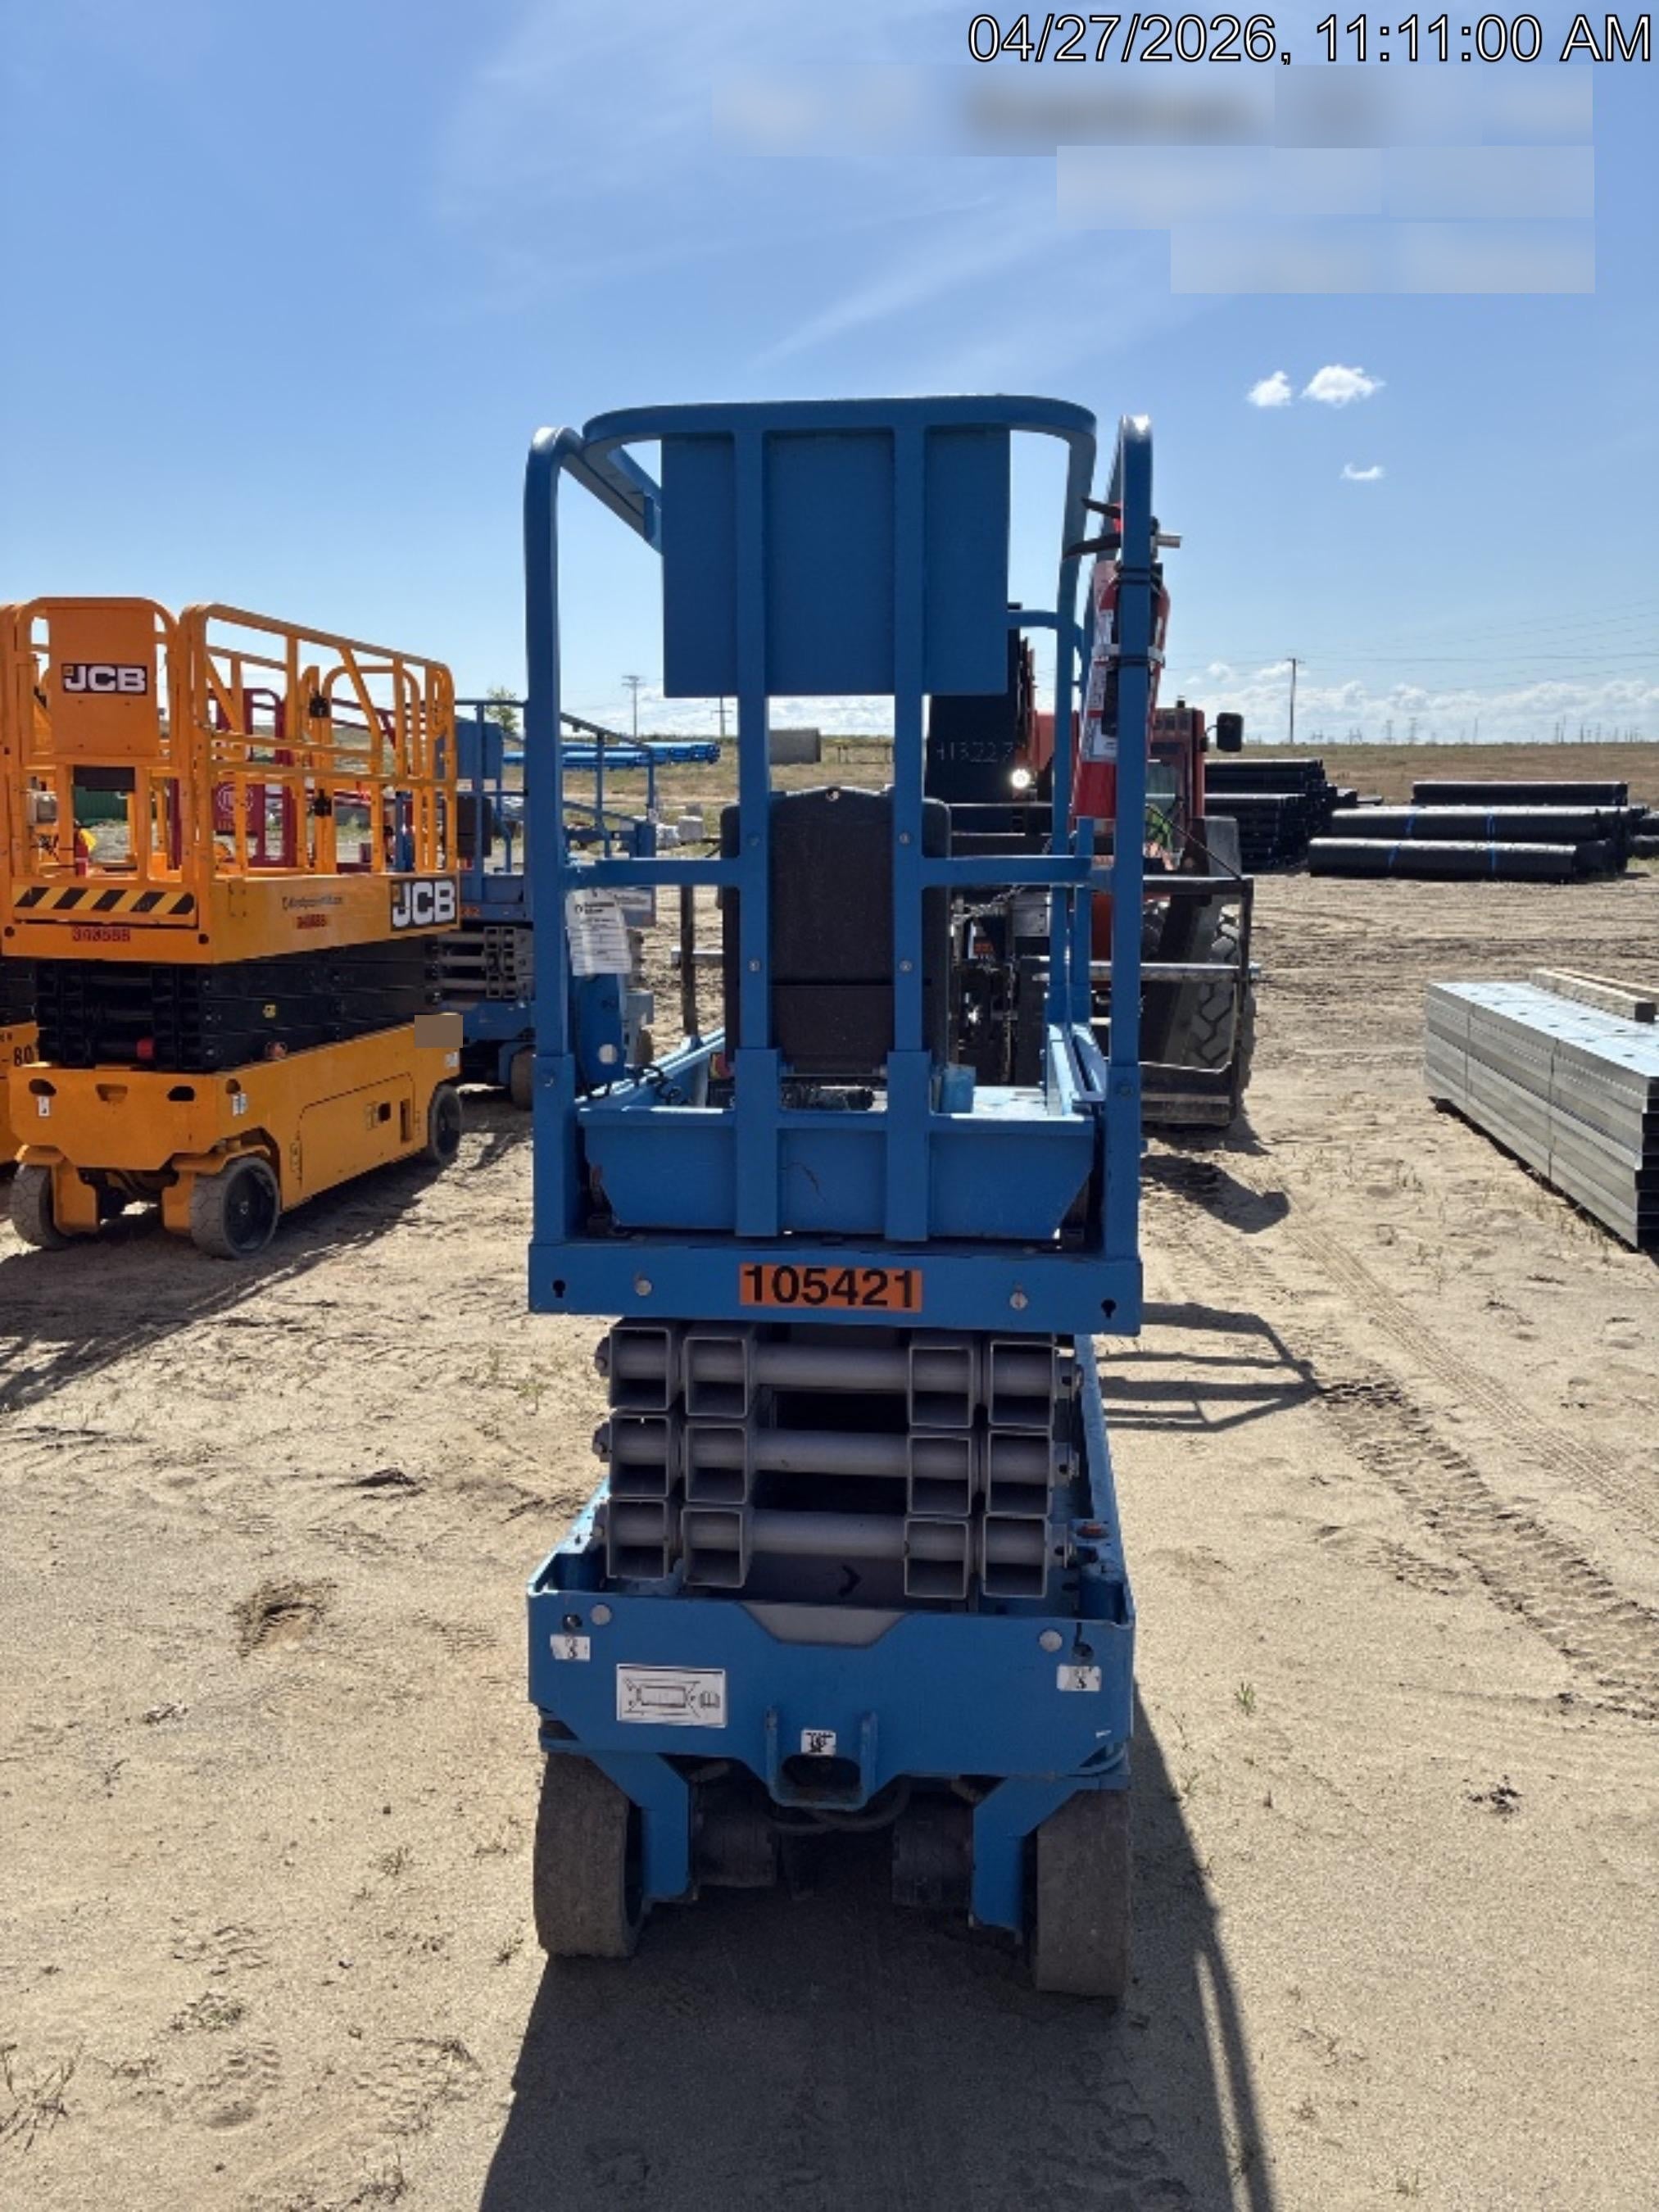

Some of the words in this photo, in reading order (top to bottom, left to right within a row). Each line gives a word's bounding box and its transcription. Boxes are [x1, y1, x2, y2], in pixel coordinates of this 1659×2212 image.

[64, 665, 146, 691] JCB
[392, 881, 456, 927] JCB
[744, 1266, 912, 1308] 105421
